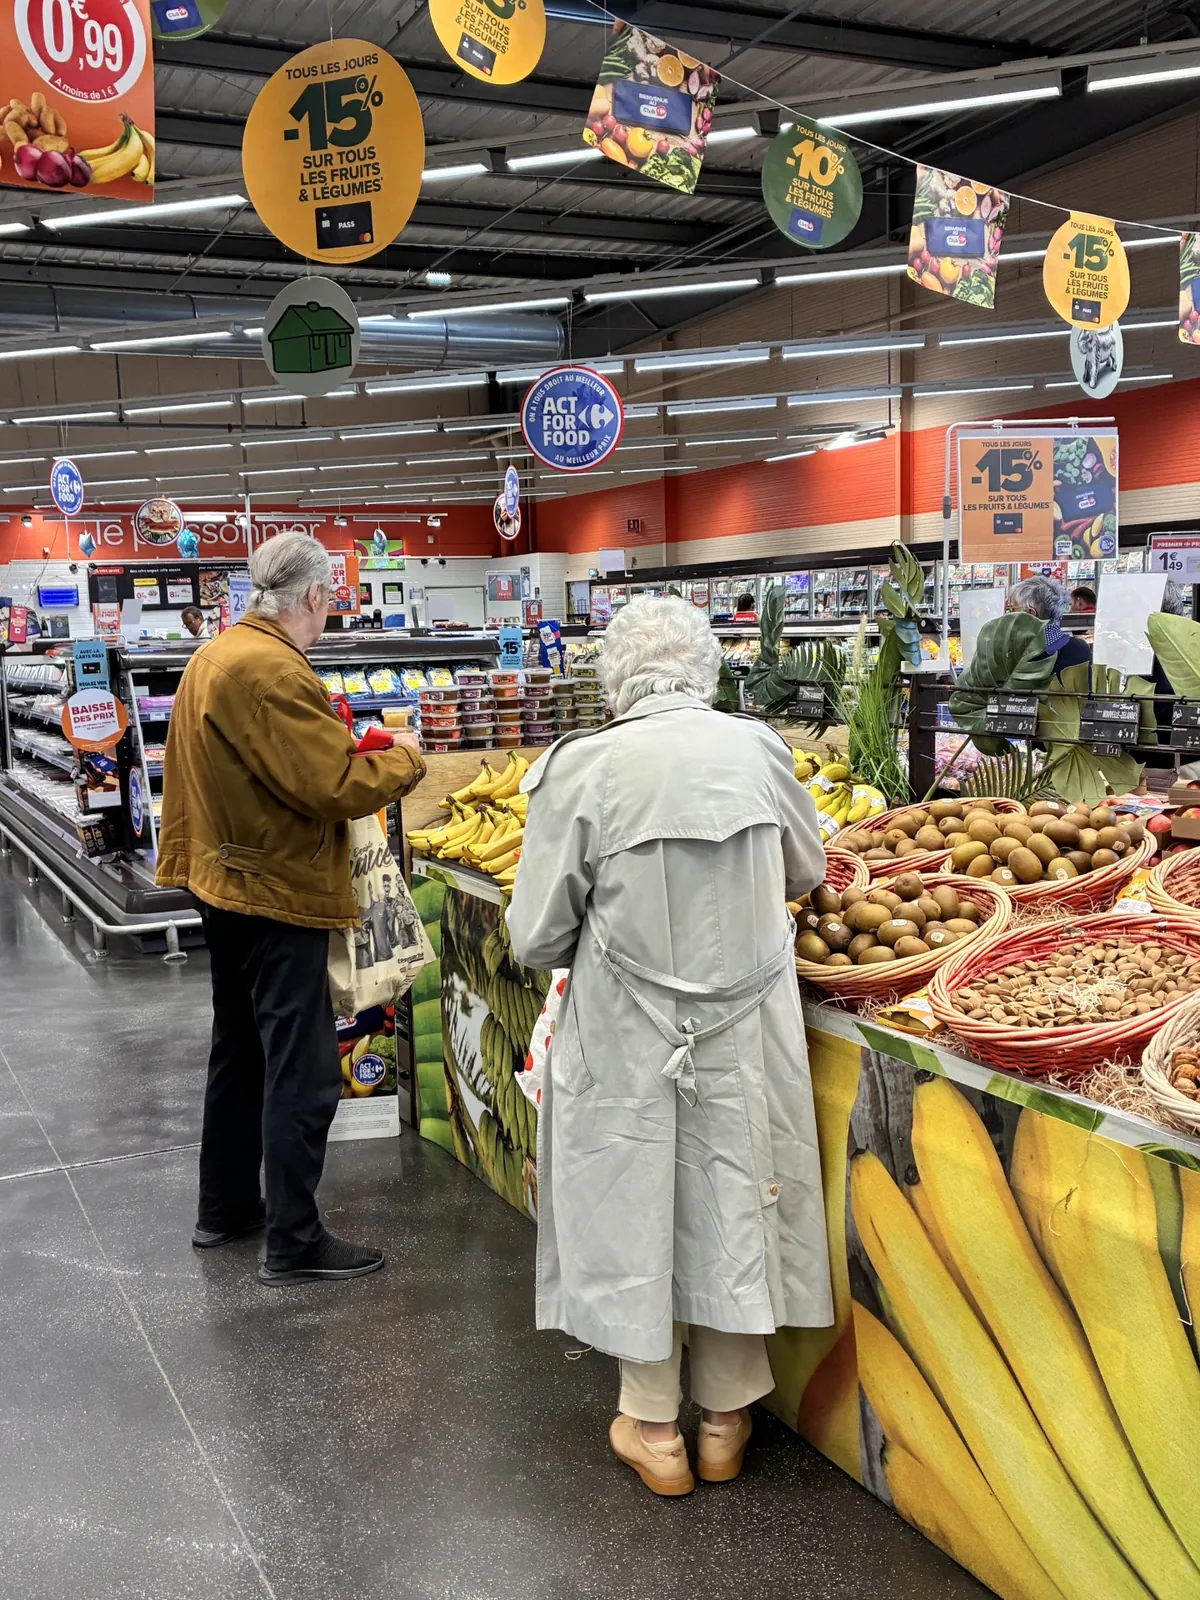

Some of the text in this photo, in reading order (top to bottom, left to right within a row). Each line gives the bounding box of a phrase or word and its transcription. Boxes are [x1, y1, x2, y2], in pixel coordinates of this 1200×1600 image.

[455, 15, 462, 25] &
[460, 6, 477, 23] LES
[477, 19, 509, 46] FRUITS
[464, 0, 484, 17] SUR
[485, 13, 510, 35] TOUS
[285, 53, 379, 80] TOUS LES JOURS
[54, 77, 62, 87] A
[62, 83, 89, 100] moins
[90, 91, 101, 100] de
[284, 74, 383, 151] -15%
[796, 124, 847, 154] TOUS LES JOURS
[303, 146, 376, 169] SUR TOUS
[785, 138, 845, 187] -10%
[300, 162, 380, 186] LES FRUITS
[298, 188, 309, 202] &
[788, 185, 834, 210] LES FRUITS
[792, 178, 834, 200] SUR TOUS
[785, 194, 792, 203] &
[338, 221, 355, 229] PASS
[1070, 221, 1114, 237] TOUS LES JOURS
[1063, 232, 1115, 272] -15%
[1067, 278, 1109, 291] LES FRUITS
[1069, 270, 1108, 283] SUR TOUS
[1065, 286, 1070, 294] &
[544, 376, 563, 391] DROIT
[564, 374, 574, 382] AU
[575, 375, 606, 397] MEILLEUR
[532, 389, 546, 404] TOUS
[542, 396, 578, 415] ACT
[529, 412, 536, 423] ON
[542, 414, 577, 431] FOR
[543, 430, 591, 447] FOOD
[554, 434, 612, 464] AU MEILLEUR PRIX
[971, 448, 1043, 493] -15%
[58, 493, 75, 503] FOOD
[963, 503, 977, 511] LES
[978, 502, 1006, 511] FRUITS
[1006, 494, 1027, 502] TOUS
[71, 701, 114, 715] BAISSE
[73, 716, 92, 724] DES
[93, 711, 115, 720] PRIX
